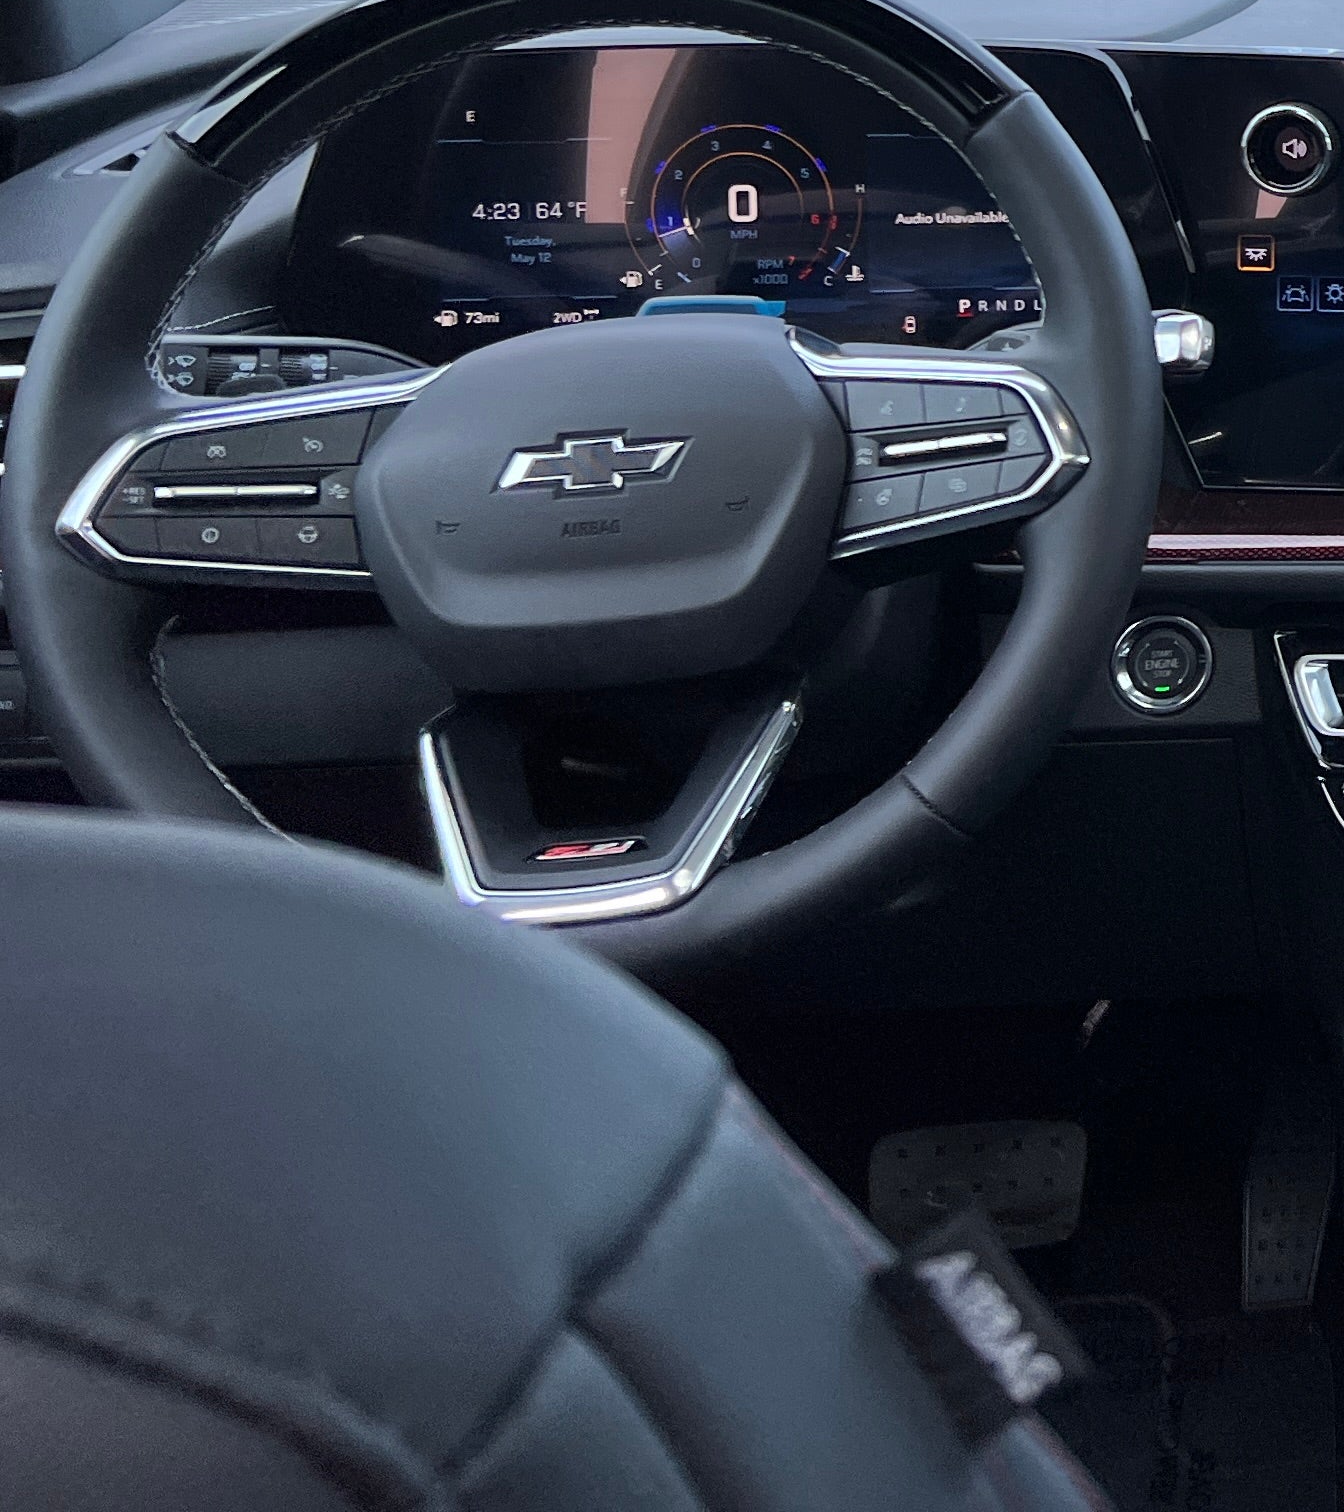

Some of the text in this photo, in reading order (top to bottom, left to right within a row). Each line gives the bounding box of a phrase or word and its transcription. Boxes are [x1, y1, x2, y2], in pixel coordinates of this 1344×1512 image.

[465, 110, 477, 123] E
[727, 184, 759, 223] 0
[471, 202, 521, 220] 4:23
[534, 202, 563, 219] 64
[894, 210, 1010, 225] Audio Unavailable
[730, 228, 759, 240] MPH
[511, 252, 552, 266] May 12
[757, 258, 784, 270] RPM
[958, 299, 972, 314] P
[465, 312, 501, 325] 73mi
[552, 312, 583, 325] 2WD
[1144, 657, 1181, 671] ENGINE
